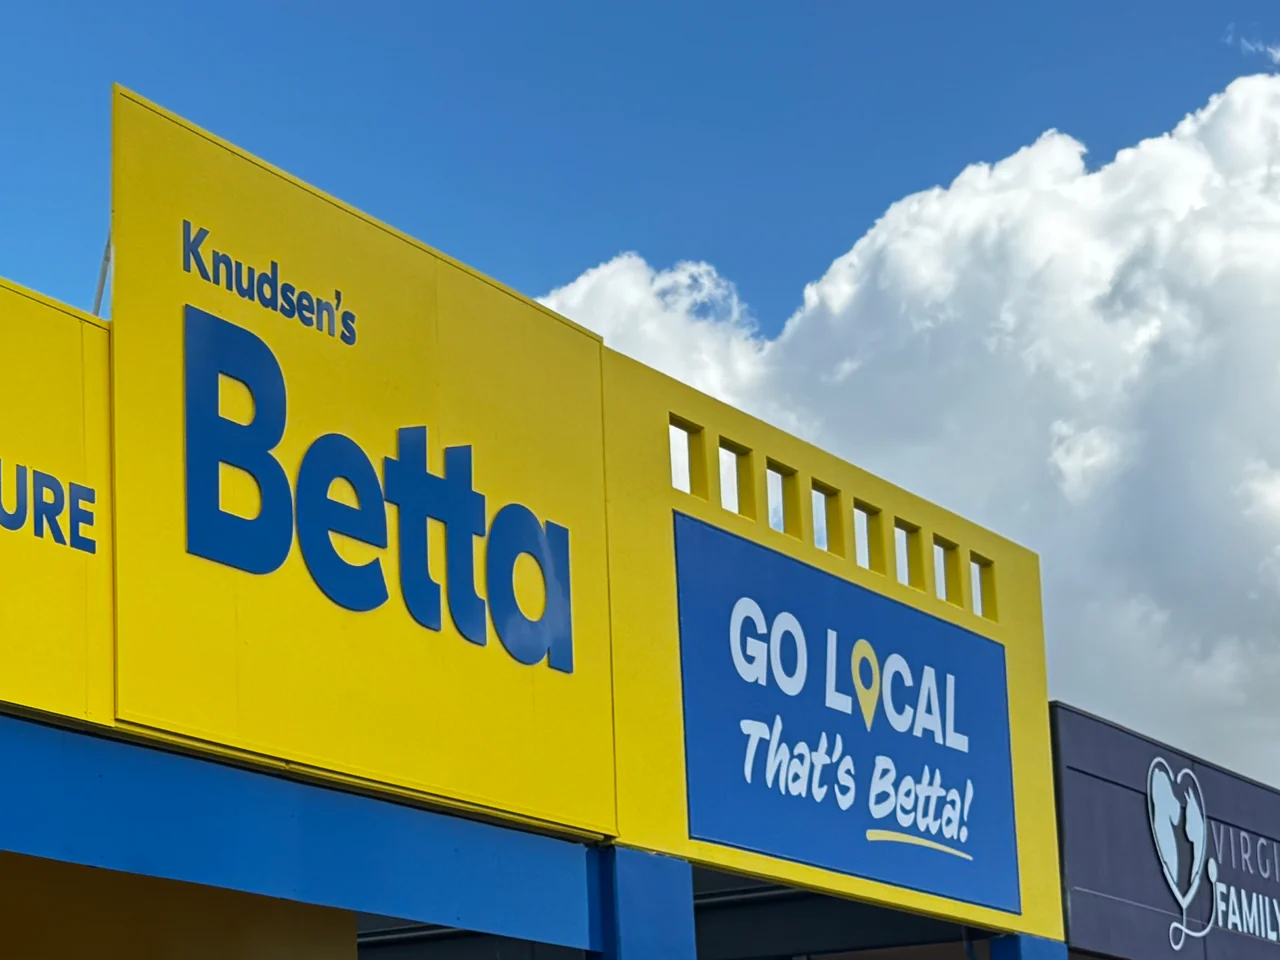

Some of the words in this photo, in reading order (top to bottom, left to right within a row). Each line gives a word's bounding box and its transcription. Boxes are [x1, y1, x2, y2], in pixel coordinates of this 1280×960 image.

[182, 219, 357, 345] Knudsen's
[183, 303, 574, 674] Betta
[729, 596, 808, 696] GO
[825, 628, 969, 753] LOCAL
[739, 713, 856, 811] That's
[868, 755, 974, 843] Betta!
[1211, 820, 1280, 882] VIRGI
